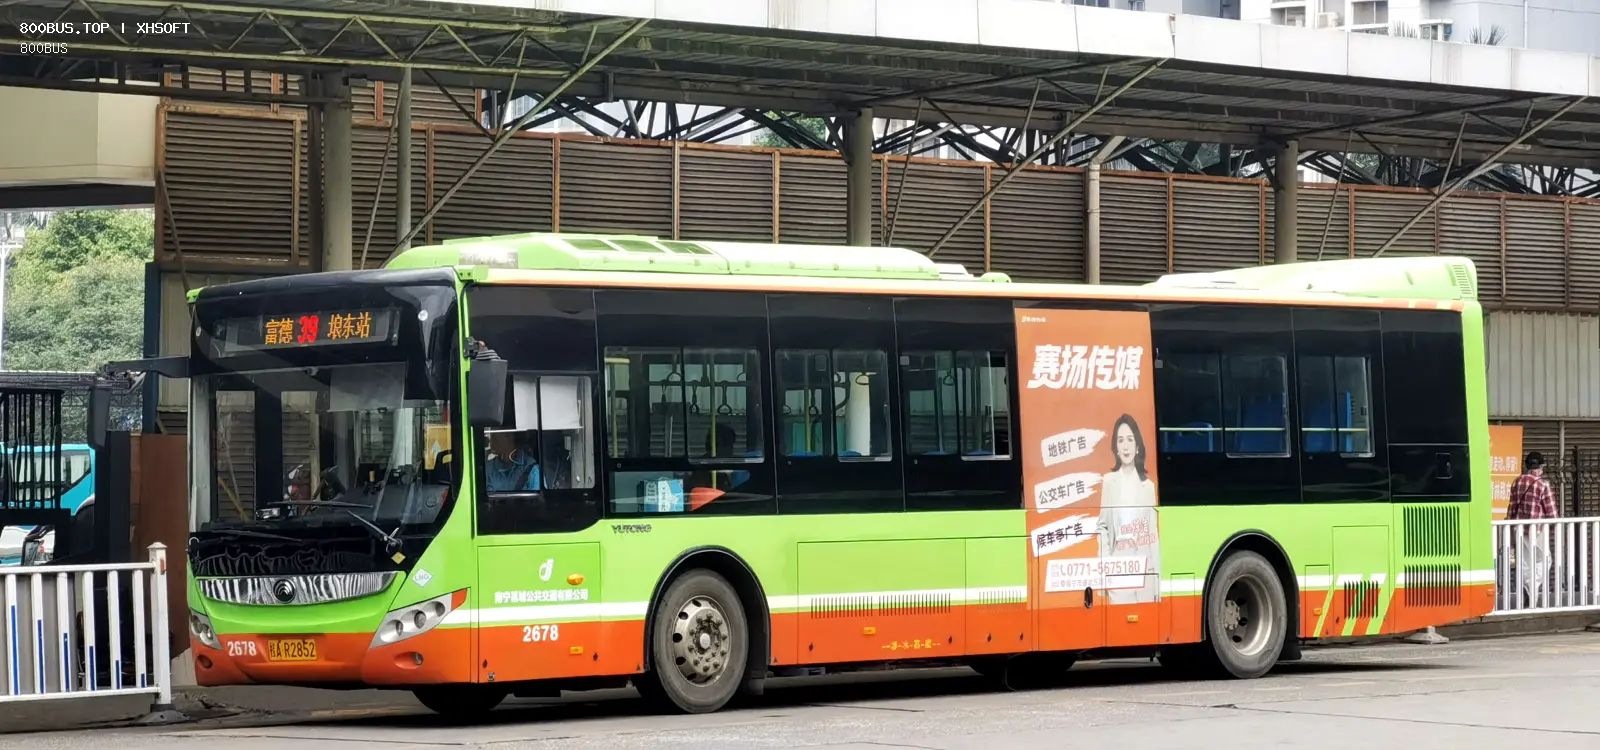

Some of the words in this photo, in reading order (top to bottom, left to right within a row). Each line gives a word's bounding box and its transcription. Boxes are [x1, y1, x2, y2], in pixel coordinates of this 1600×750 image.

[264, 317, 294, 345] 富德
[297, 314, 320, 344] 39
[1026, 343, 1144, 390] 赛扬传媒
[1047, 435, 1087, 458] 地铁广告
[1038, 479, 1085, 505] 公交车广告
[1036, 521, 1084, 549] 候车亭广告
[1066, 560, 1140, 577] 0771-5675180
[494, 588, 589, 604] 南宁公共交通有限公司
[522, 624, 559, 643] 2678
[227, 640, 257, 656] 2678
